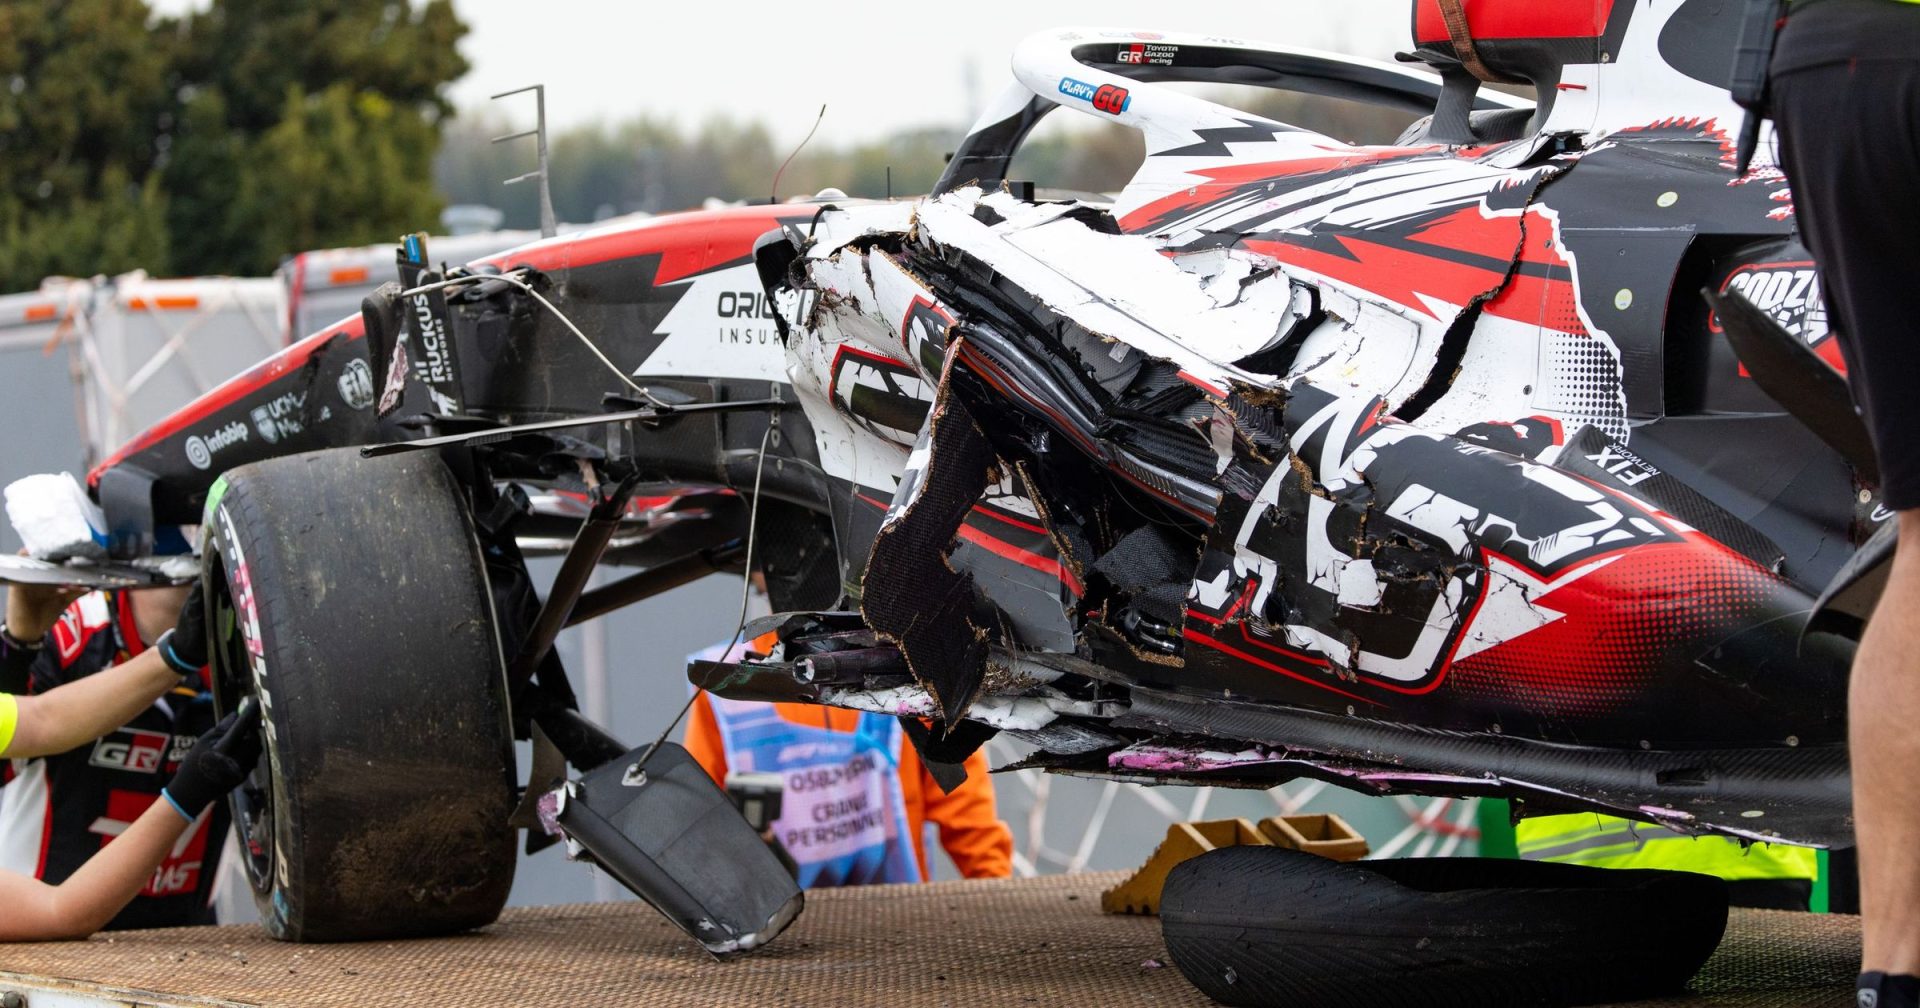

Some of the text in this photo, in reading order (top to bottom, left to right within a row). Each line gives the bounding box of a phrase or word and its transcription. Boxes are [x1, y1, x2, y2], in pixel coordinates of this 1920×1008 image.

[1117, 51, 1142, 64] GR
[1093, 84, 1127, 114] GO
[413, 293, 446, 382] RUCKUS
[435, 318, 453, 381] NETWORKS
[719, 327, 780, 344] INSUR
[204, 421, 248, 453] infobip
[1584, 446, 1652, 486] FIX
[1608, 442, 1661, 476] NETWORK
[95, 742, 159, 769] GR
